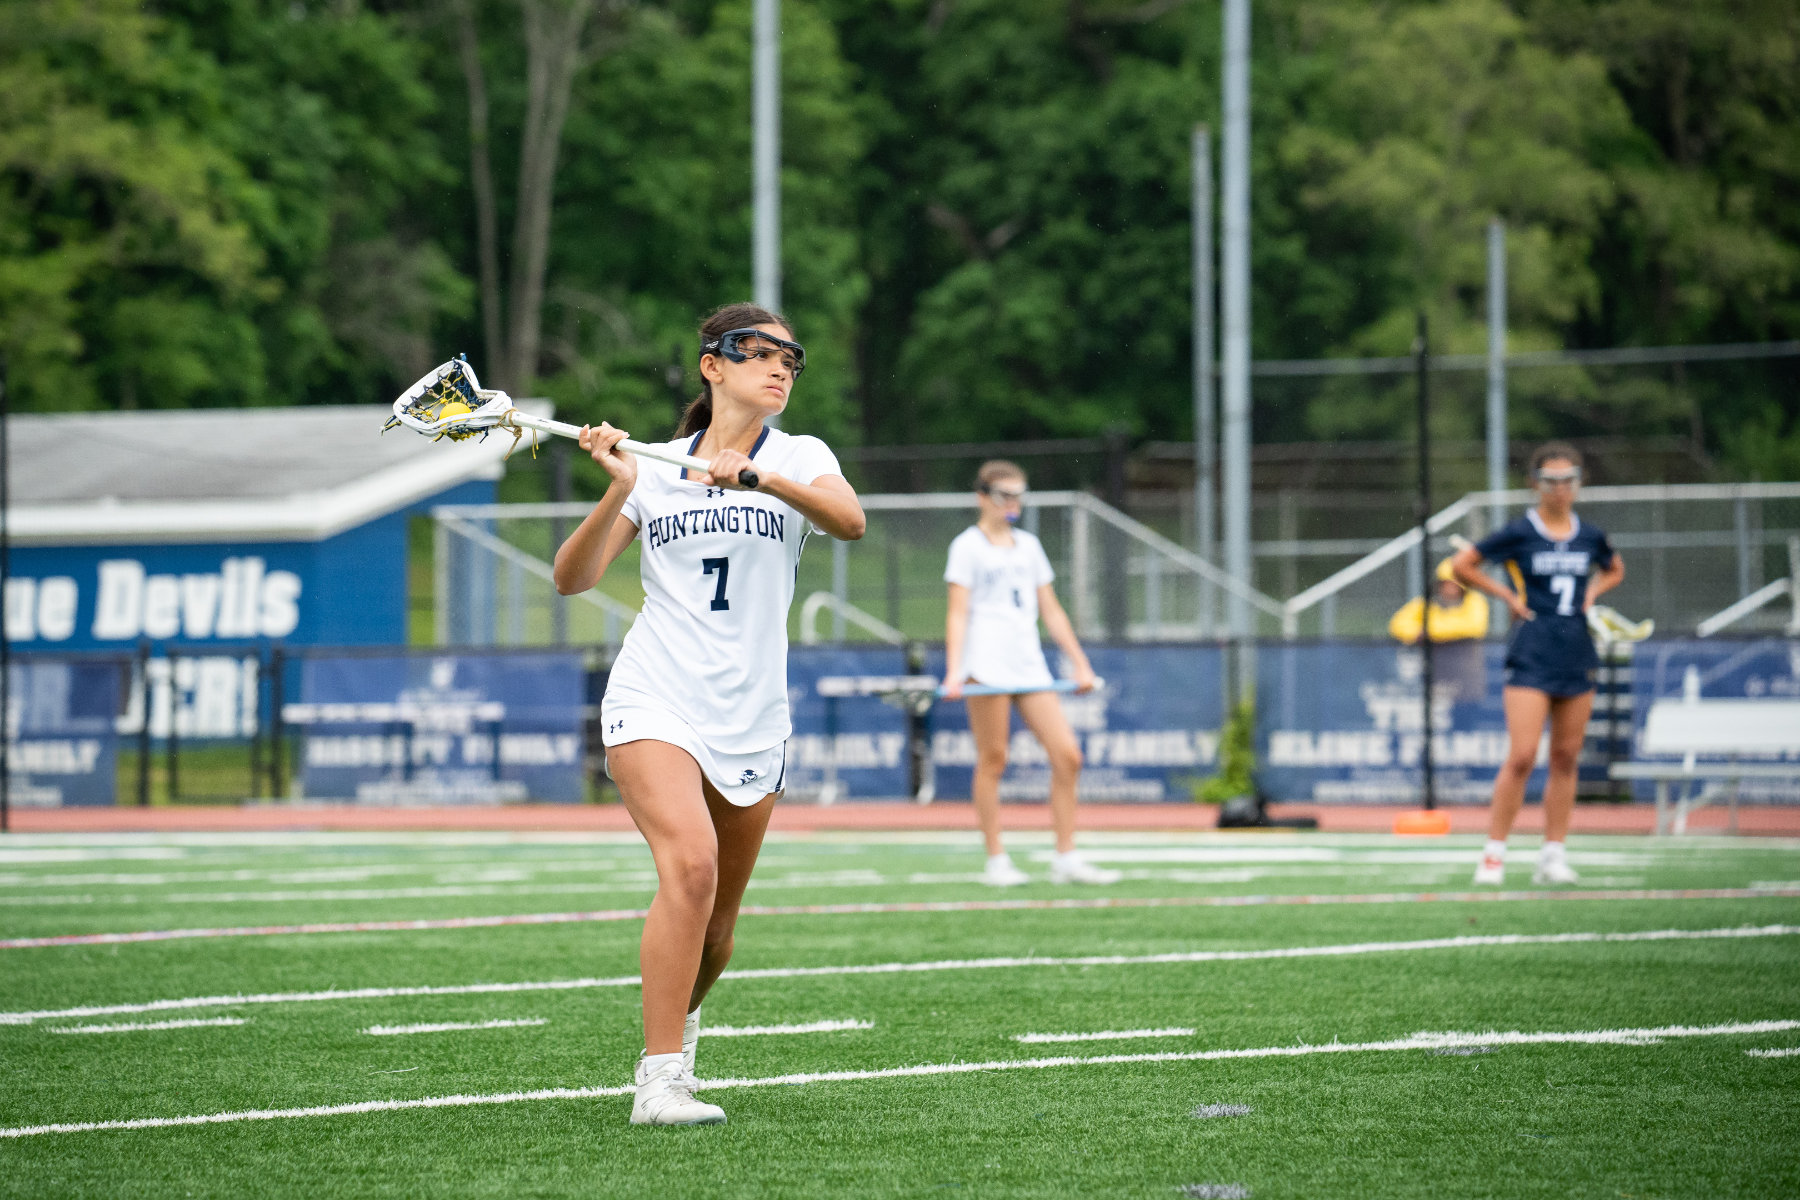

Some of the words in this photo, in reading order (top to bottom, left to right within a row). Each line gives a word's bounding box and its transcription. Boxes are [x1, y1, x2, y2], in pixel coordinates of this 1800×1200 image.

[648, 505, 785, 551] HUNTINGTON
[91, 557, 302, 640] Devils
[701, 556, 730, 612] 7
[1550, 575, 1576, 616] 7
